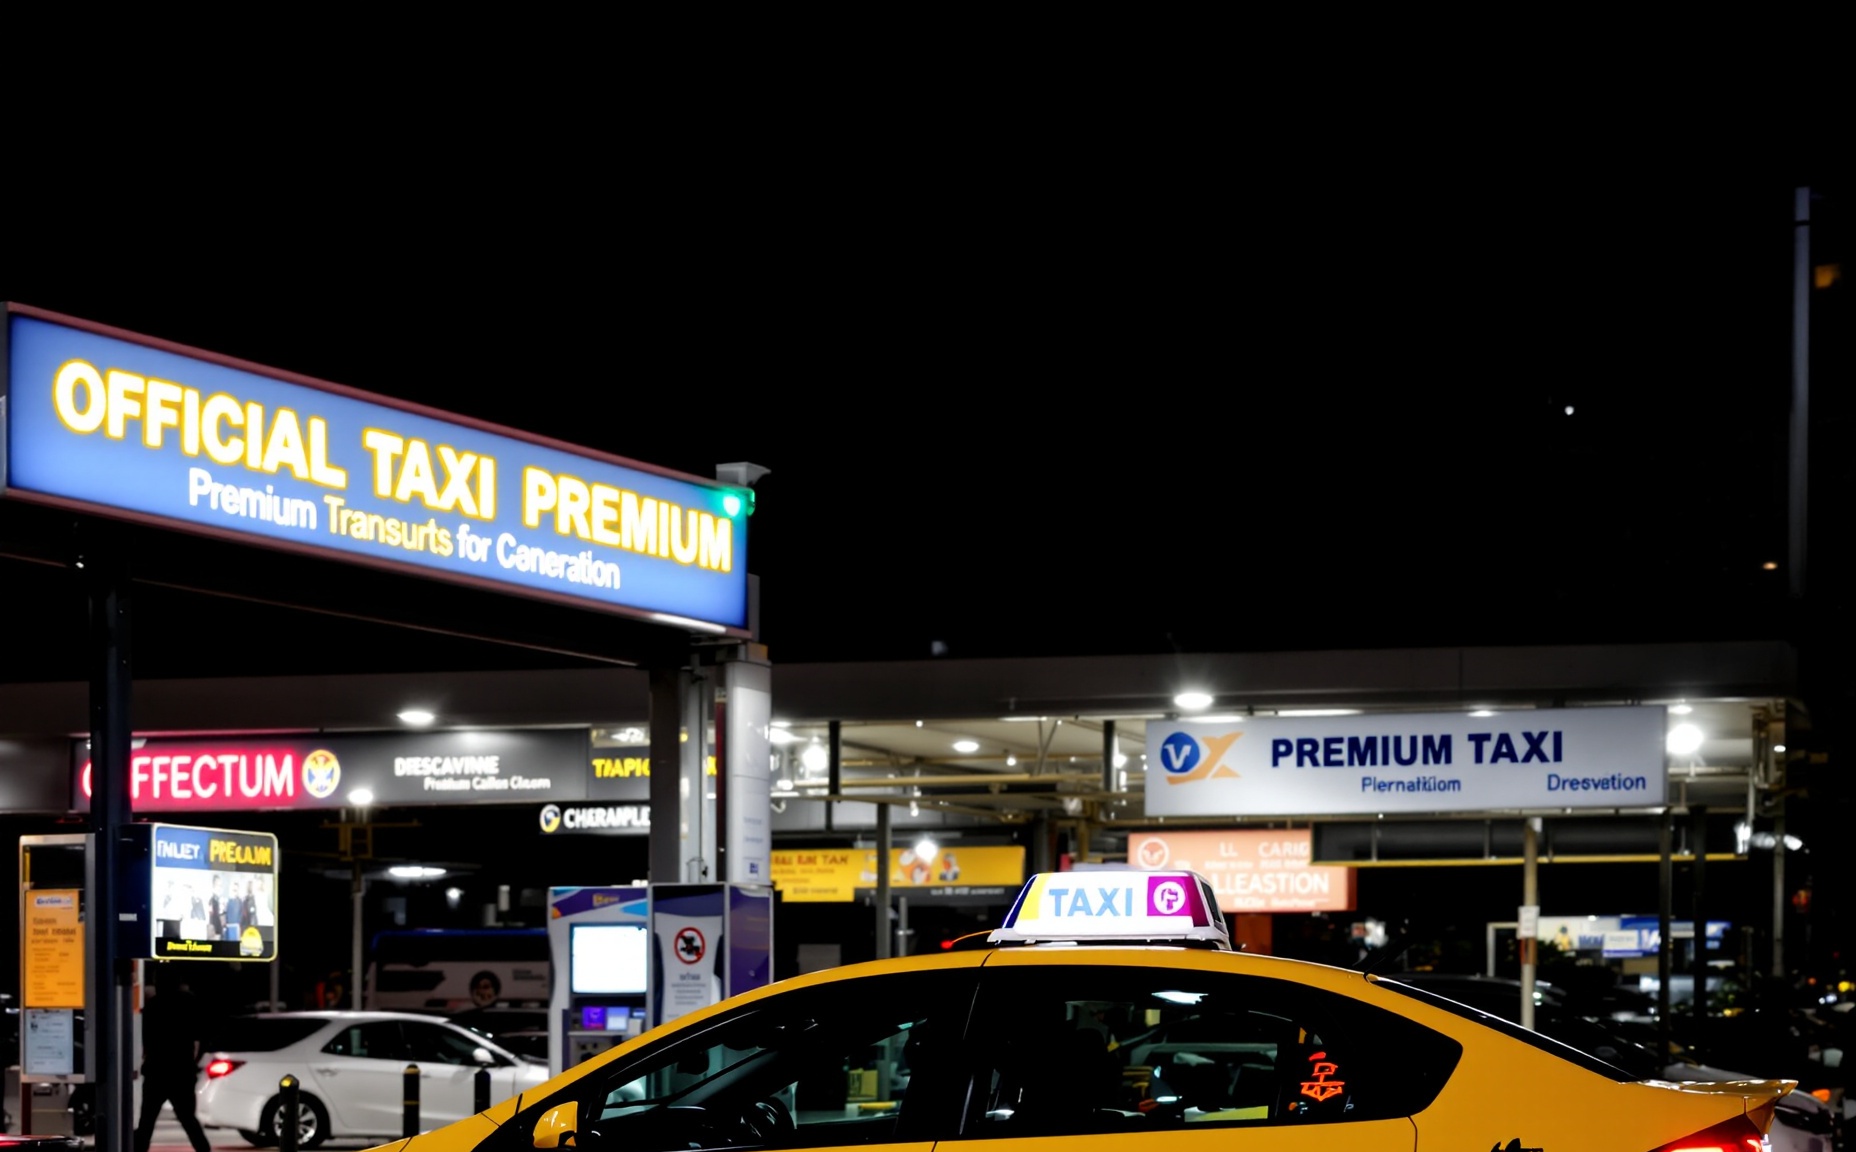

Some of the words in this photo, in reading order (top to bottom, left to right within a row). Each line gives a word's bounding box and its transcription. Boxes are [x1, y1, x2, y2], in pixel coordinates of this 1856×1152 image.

[54, 358, 347, 489] OFFICIAL
[363, 427, 497, 520] TAXI
[522, 466, 733, 574] PREMIUM
[188, 467, 318, 531] Premium
[323, 494, 454, 558] Transurts
[456, 524, 492, 563] for
[496, 532, 621, 591] Caneration
[1271, 735, 1452, 768] PREMIUM
[1467, 730, 1563, 764] TAXI
[81, 753, 295, 800] FFECTUM
[1049, 887, 1133, 917] TAXI
